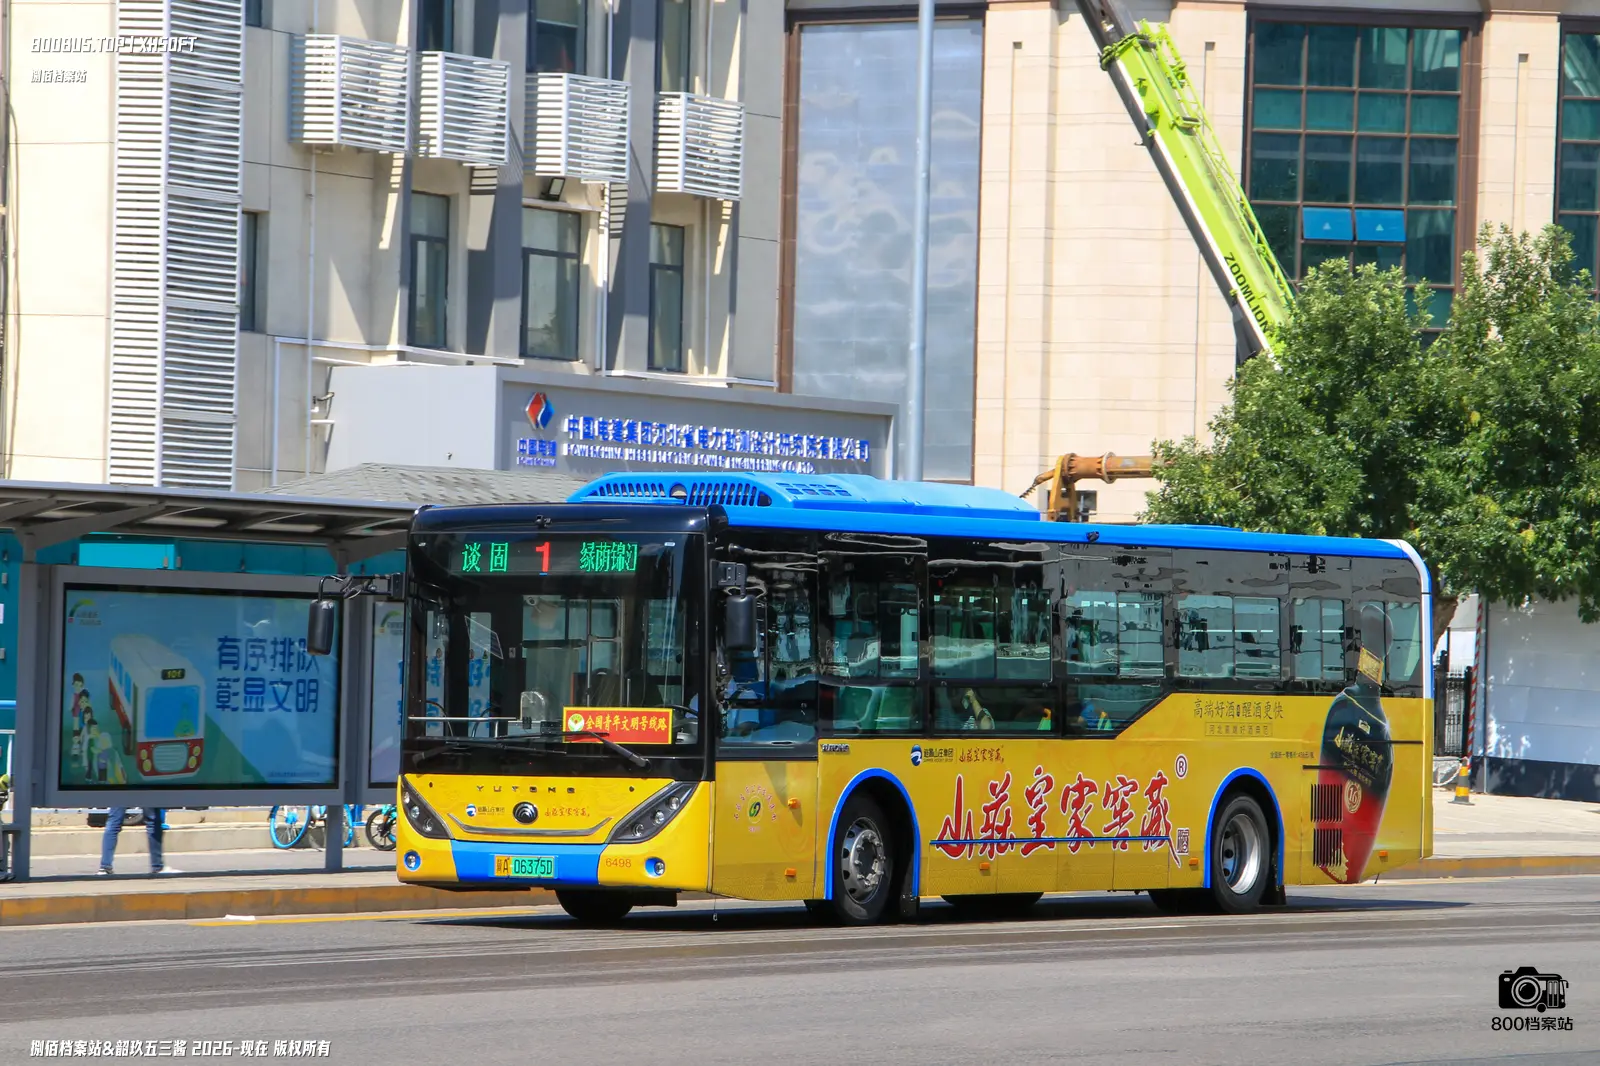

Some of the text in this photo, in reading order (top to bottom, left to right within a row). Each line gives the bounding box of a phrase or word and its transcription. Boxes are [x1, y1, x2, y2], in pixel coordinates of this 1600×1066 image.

[1224, 252, 1269, 334] ZOOMLION
[462, 542, 508, 572] 谈固
[535, 541, 550, 573] 1
[218, 635, 320, 674] 有序排队
[216, 677, 319, 713] 彰显文明
[586, 714, 667, 732] 全国青年文明号线路
[476, 785, 575, 794] YUTONG
[605, 857, 632, 869] 6498
